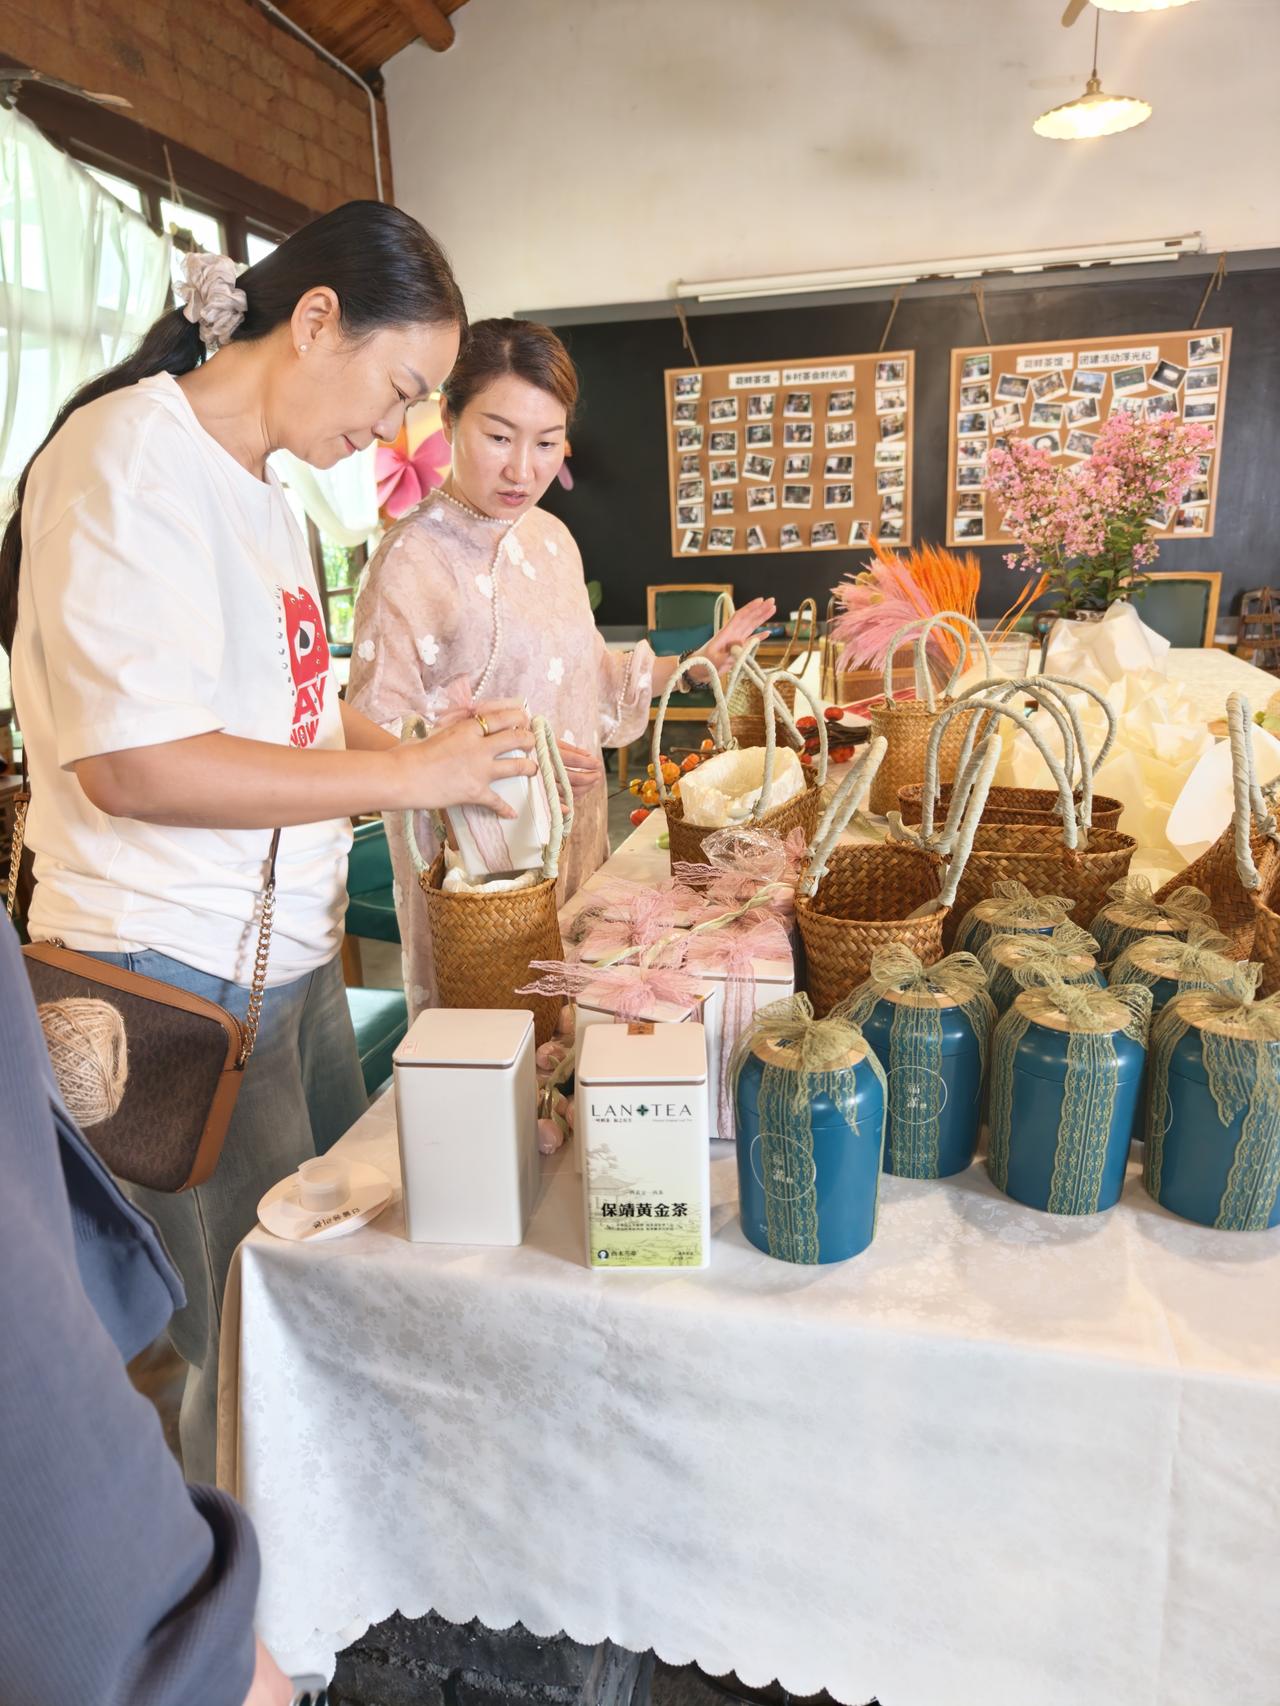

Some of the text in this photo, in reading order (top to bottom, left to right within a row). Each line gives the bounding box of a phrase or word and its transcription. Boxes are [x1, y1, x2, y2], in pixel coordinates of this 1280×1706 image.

[591, 1103, 693, 1117] LAN TEA
[601, 1202, 689, 1218] 保靖黄金茶
